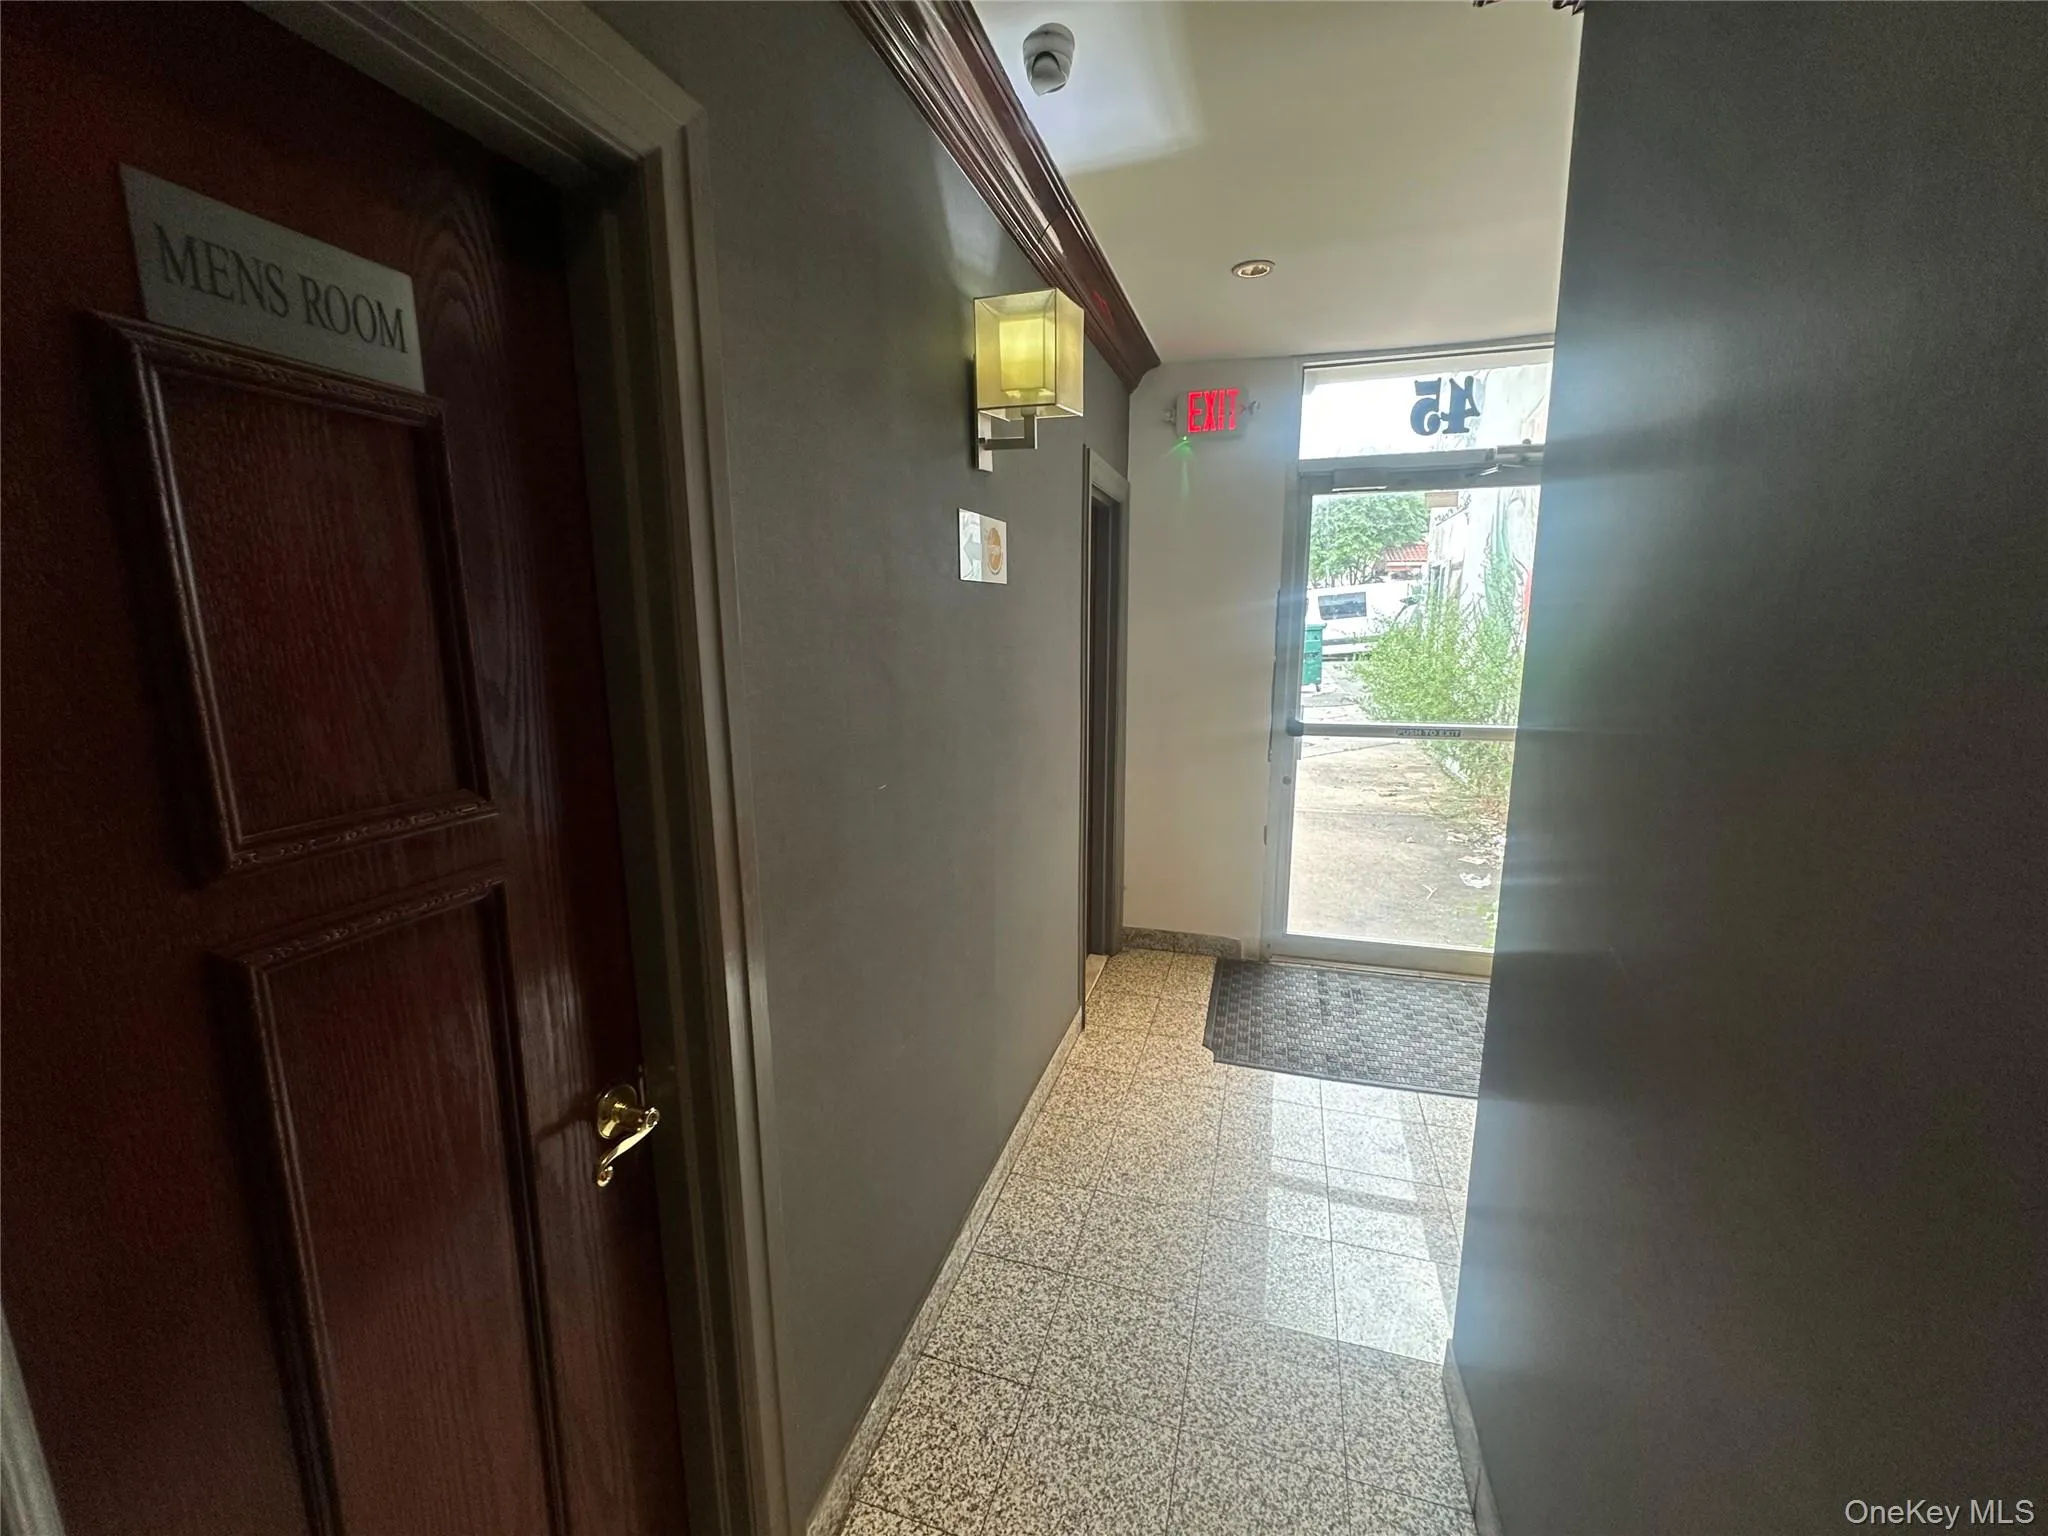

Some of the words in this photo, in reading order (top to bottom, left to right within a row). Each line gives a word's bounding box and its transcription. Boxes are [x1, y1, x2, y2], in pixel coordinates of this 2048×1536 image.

[153, 221, 289, 318] MENS
[297, 272, 408, 353] ROOM
[1187, 388, 1240, 434] EXIT
[1396, 728, 1422, 736] PUSH
[1439, 729, 1461, 737] EXIT
